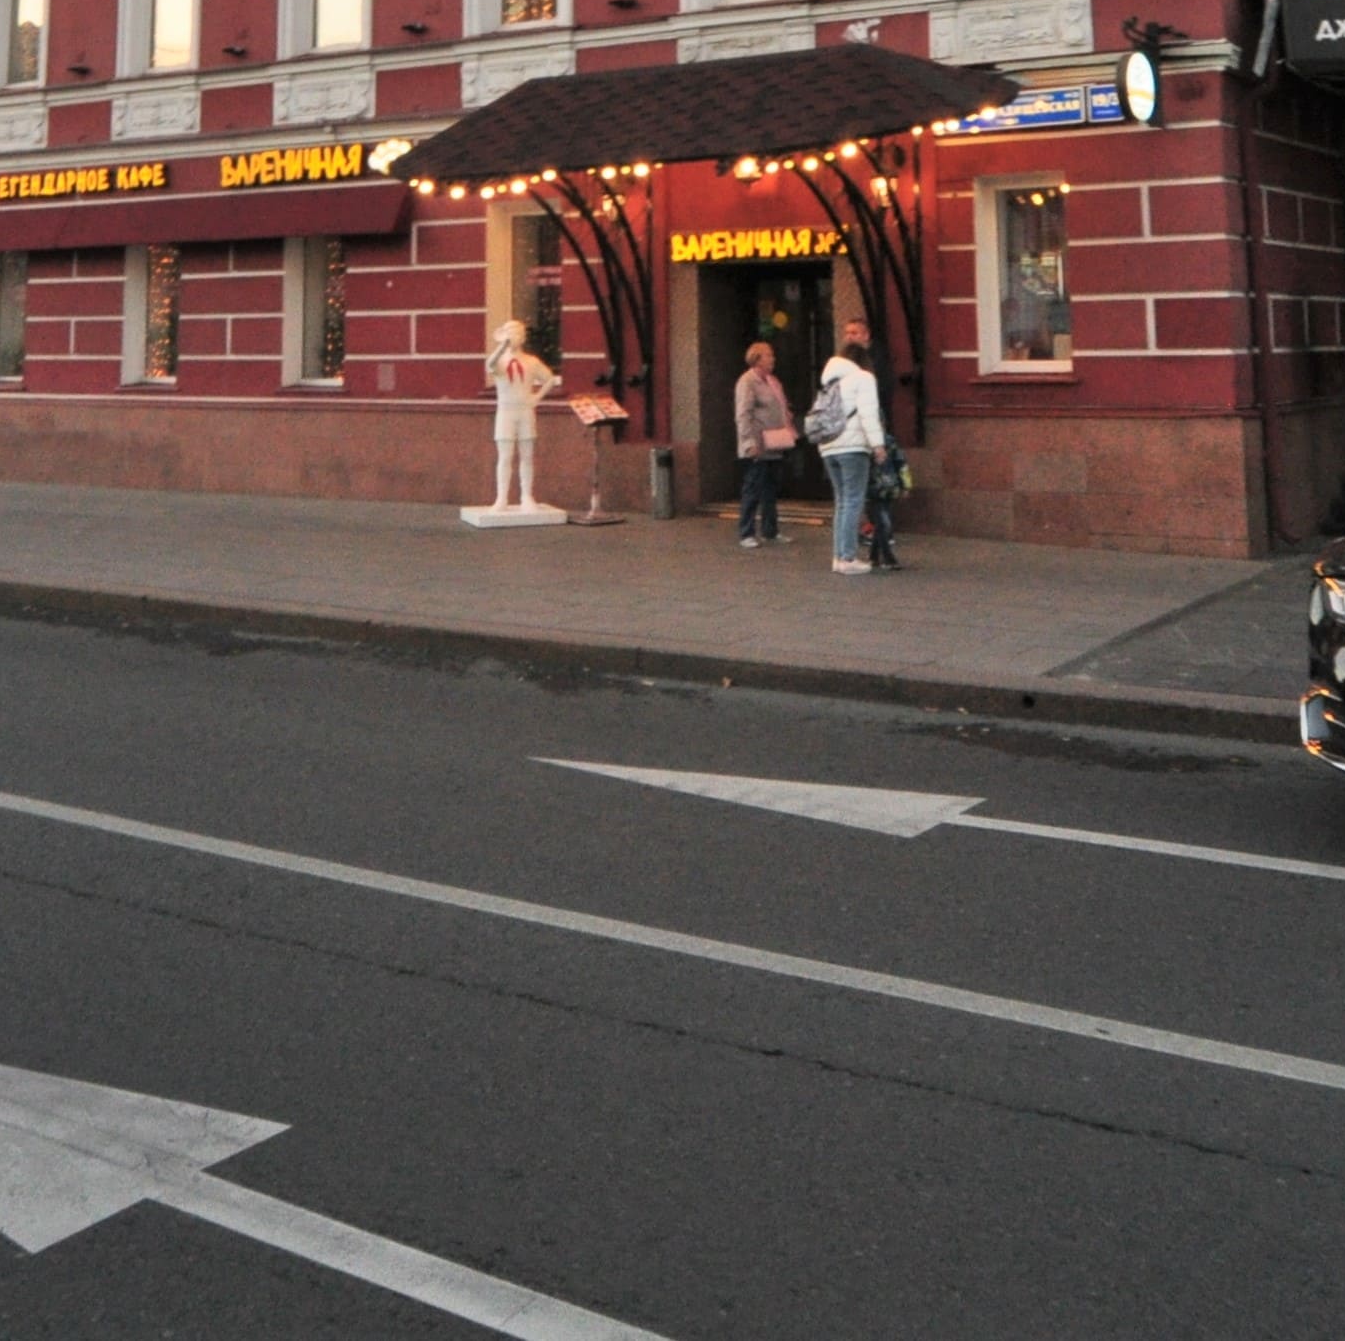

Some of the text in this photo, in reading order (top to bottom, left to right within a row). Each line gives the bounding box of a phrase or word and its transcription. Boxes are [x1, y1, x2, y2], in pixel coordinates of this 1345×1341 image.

[116, 163, 166, 190] КАФЕ
[220, 143, 363, 189] ВАРЕНИЧНАЯ
[671, 228, 812, 262] ВАРЕНИЧНАЯ
